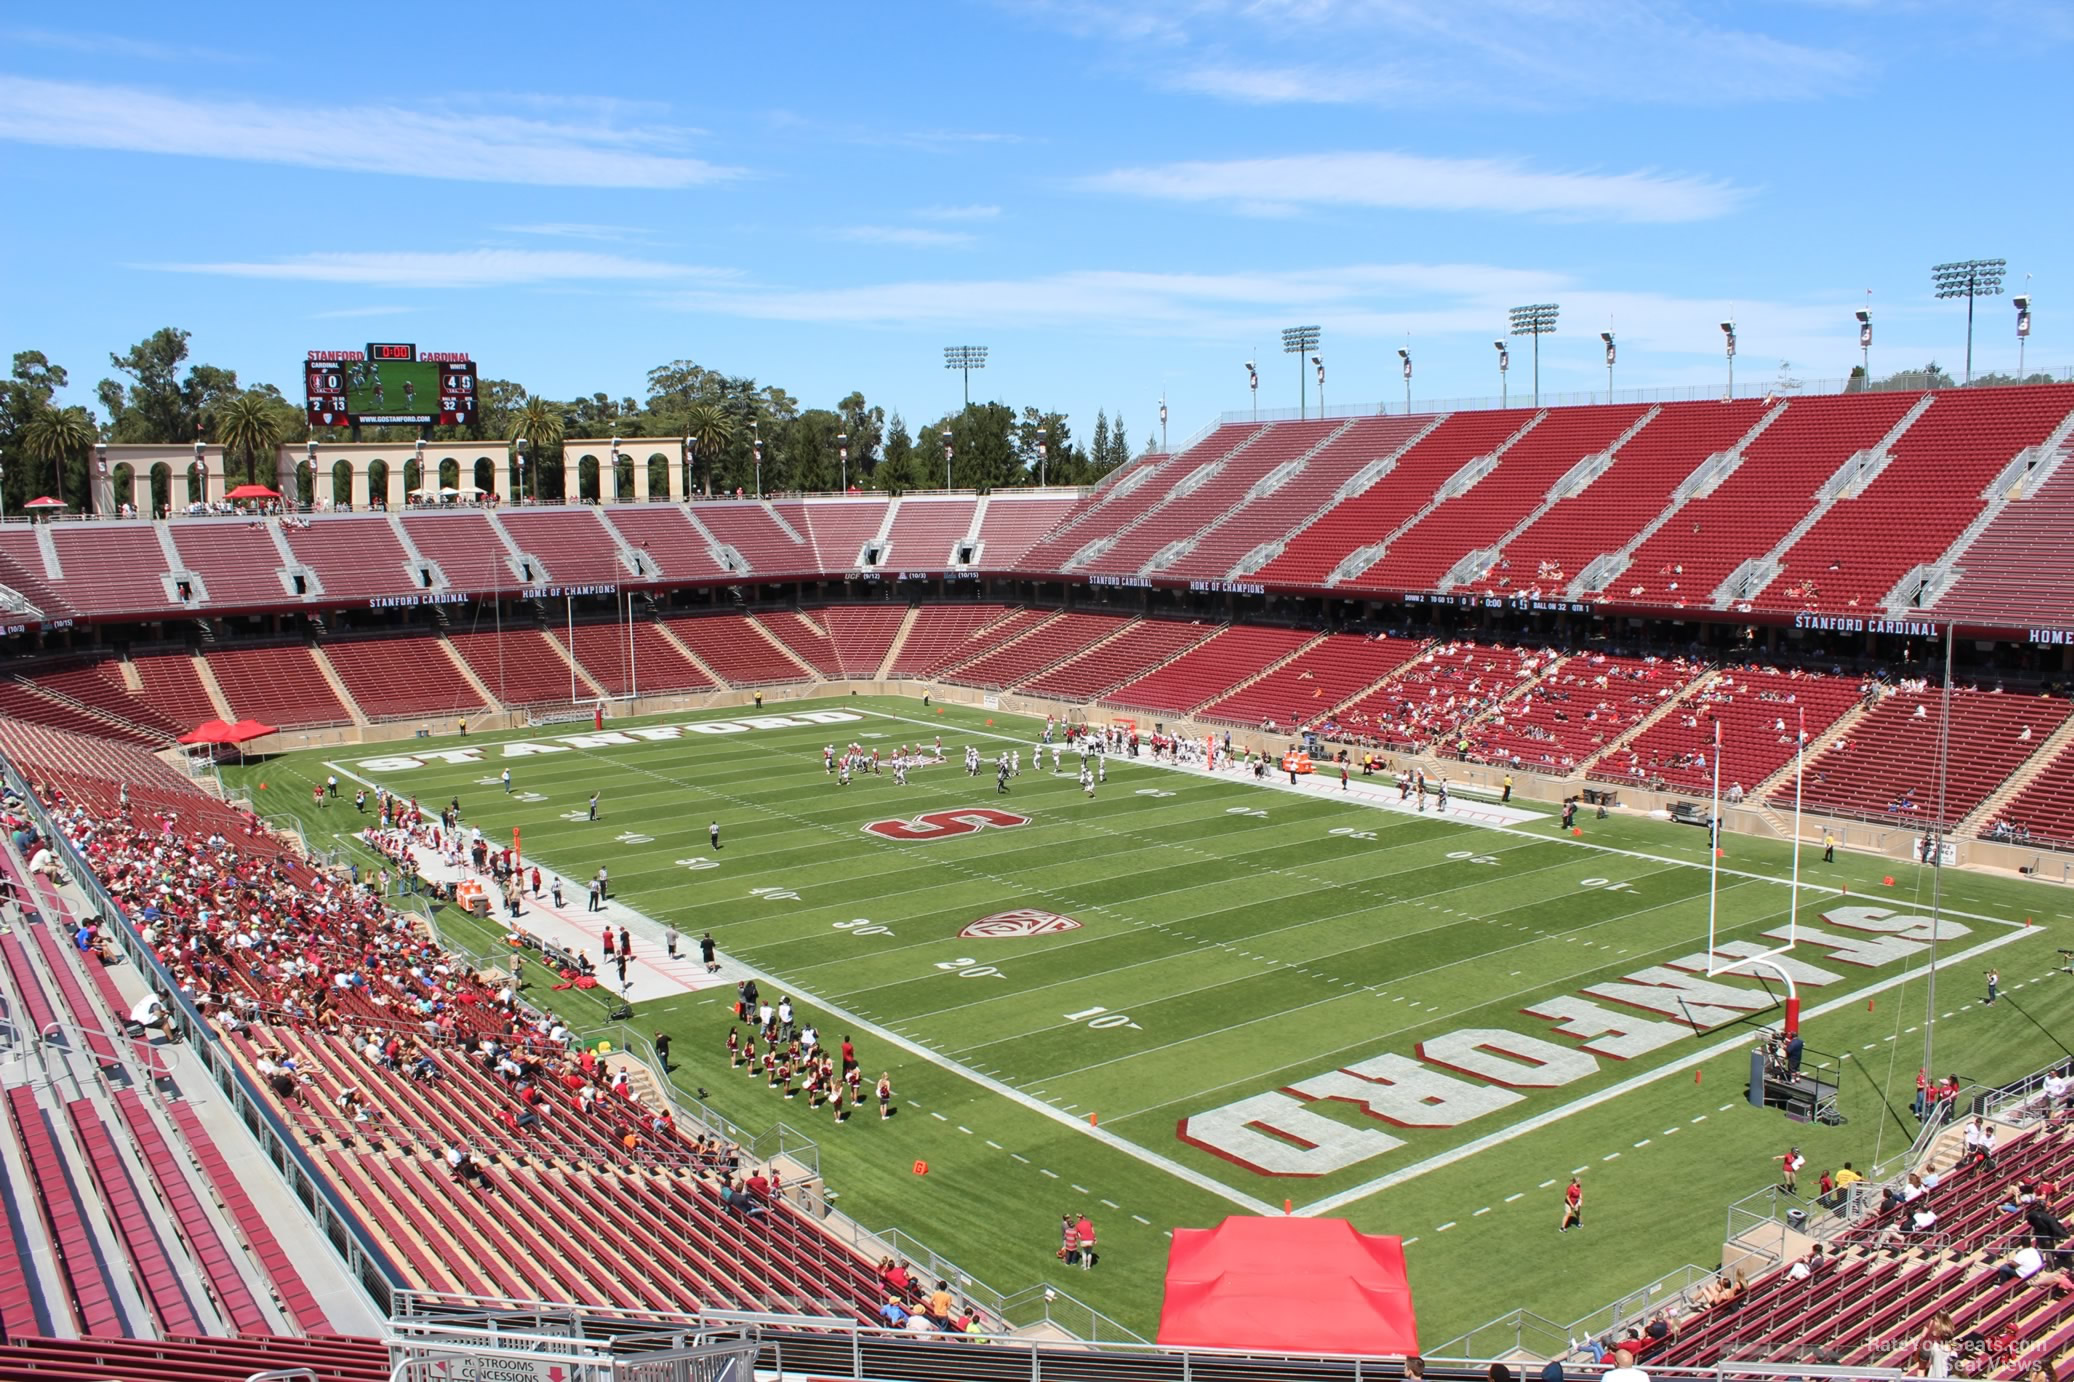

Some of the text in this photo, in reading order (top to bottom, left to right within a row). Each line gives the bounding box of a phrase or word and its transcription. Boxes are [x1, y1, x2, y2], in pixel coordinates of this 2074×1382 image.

[307, 350, 469, 362] STANFORD CARDINAL
[383, 347, 407, 357] 0:00
[328, 376, 337, 388] 0
[448, 376, 456, 388] 4
[313, 401, 320, 411] 2
[333, 401, 345, 411] 13
[444, 401, 456, 410] 32
[360, 415, 430, 423] WWW.GOSTANFORD.COM
[1089, 576, 1152, 588] STANFORD CARDINAL
[1190, 581, 1265, 594] HOME OF CHAMPIONS
[522, 584, 616, 598] HOME OF CHAMPIONS
[370, 593, 468, 608] STANFORD CARDINAL
[1404, 594, 1419, 602] DOWN
[1485, 599, 1502, 608] 0:00
[1533, 602, 1547, 610] BALL
[1558, 603, 1566, 611] 32
[1572, 604, 1583, 612] QTR
[8, 624, 25, 634] (10/3)
[54, 618, 73, 628] (10/15)
[1795, 615, 1938, 636] STANFORD CARDINAL
[2029, 629, 2074, 645] HOME
[356, 711, 866, 772] STANFORD
[675, 857, 721, 871] 50
[748, 886, 797, 900] 40
[832, 918, 888, 936] 30
[933, 957, 997, 979] 20
[1063, 1006, 1130, 1029] 10
[1176, 906, 1973, 1178] STANFORD
[464, 1358, 535, 1372] RSTROOMS
